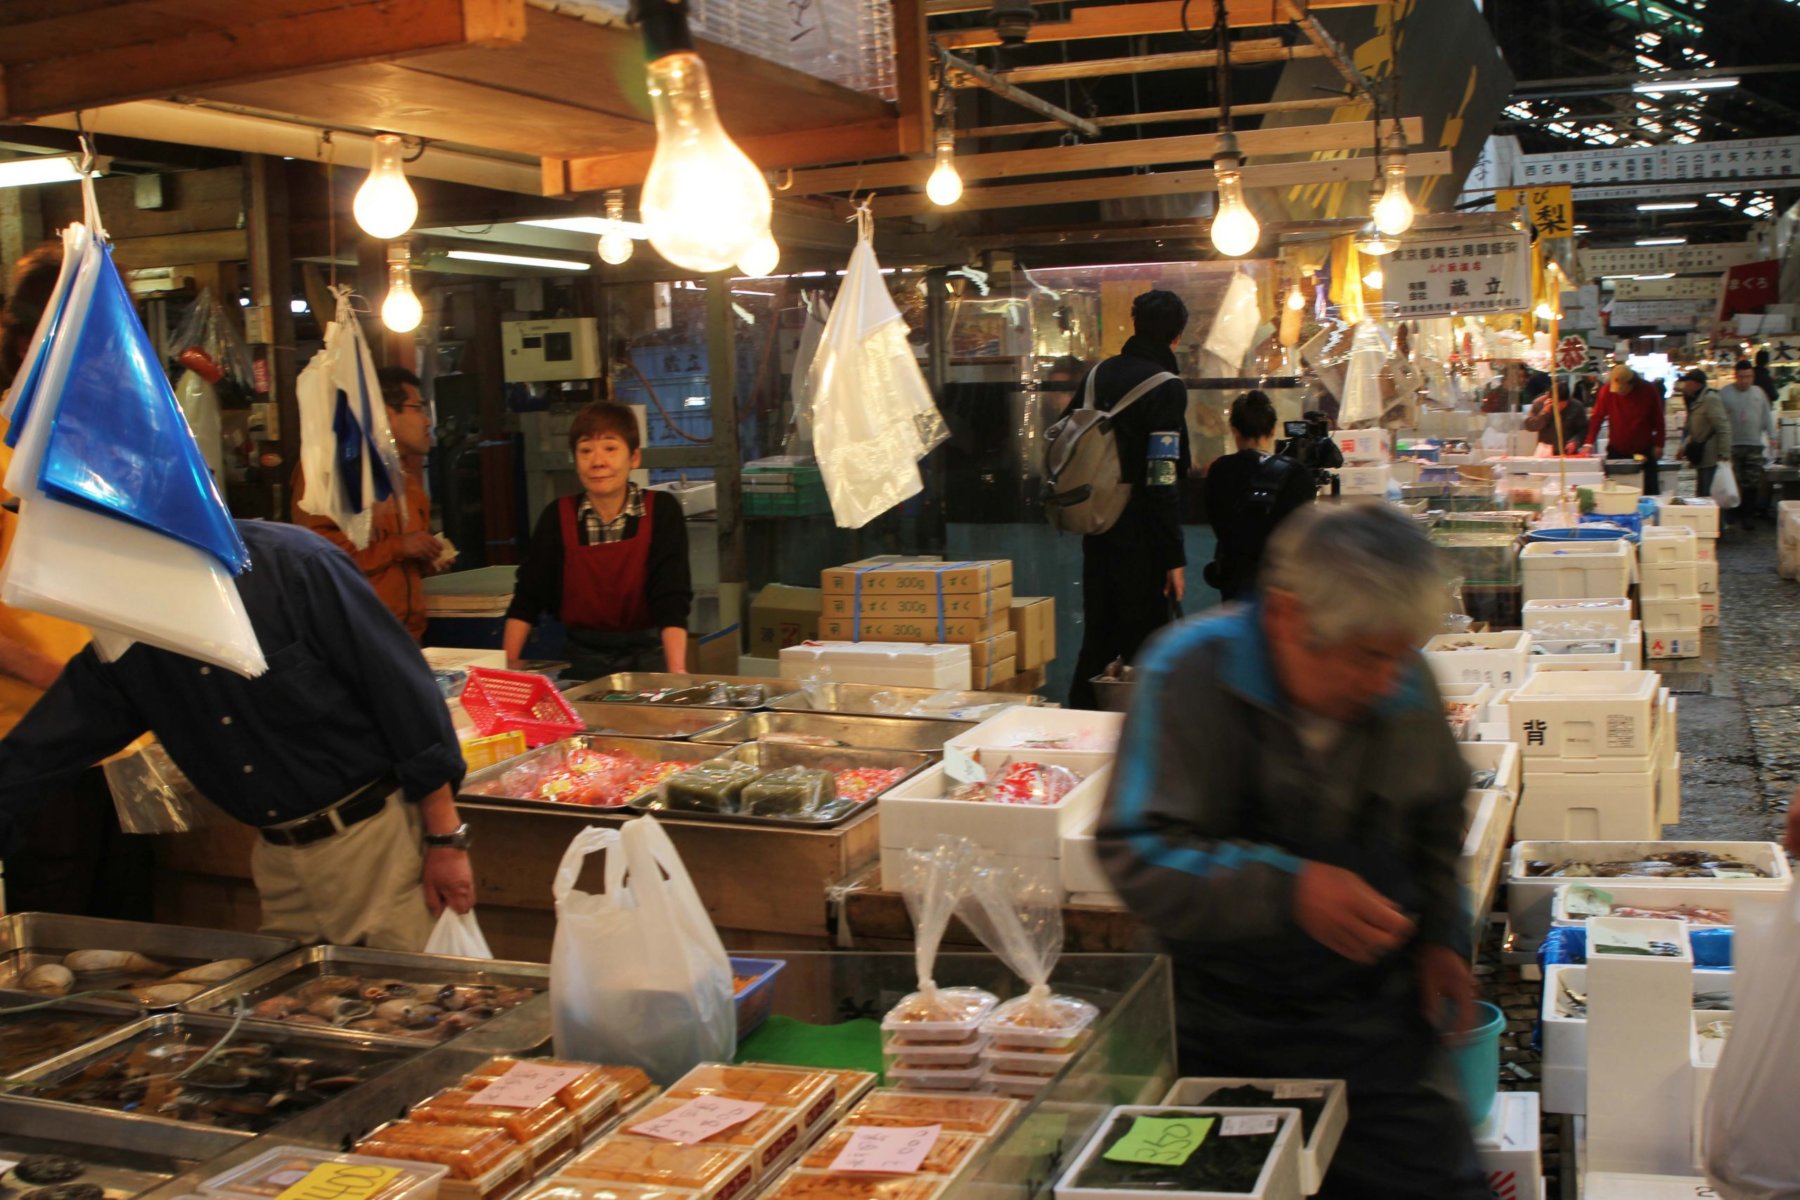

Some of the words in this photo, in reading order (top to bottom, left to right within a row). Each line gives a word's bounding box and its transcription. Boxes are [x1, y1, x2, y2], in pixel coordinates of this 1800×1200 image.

[896, 577, 925, 589] 300g
[898, 601, 928, 613] 300g
[894, 625, 922, 637] 300g
[1523, 719, 1548, 746] 背
[1134, 1123, 1192, 1163] 350
[292, 1165, 386, 1200] 400
